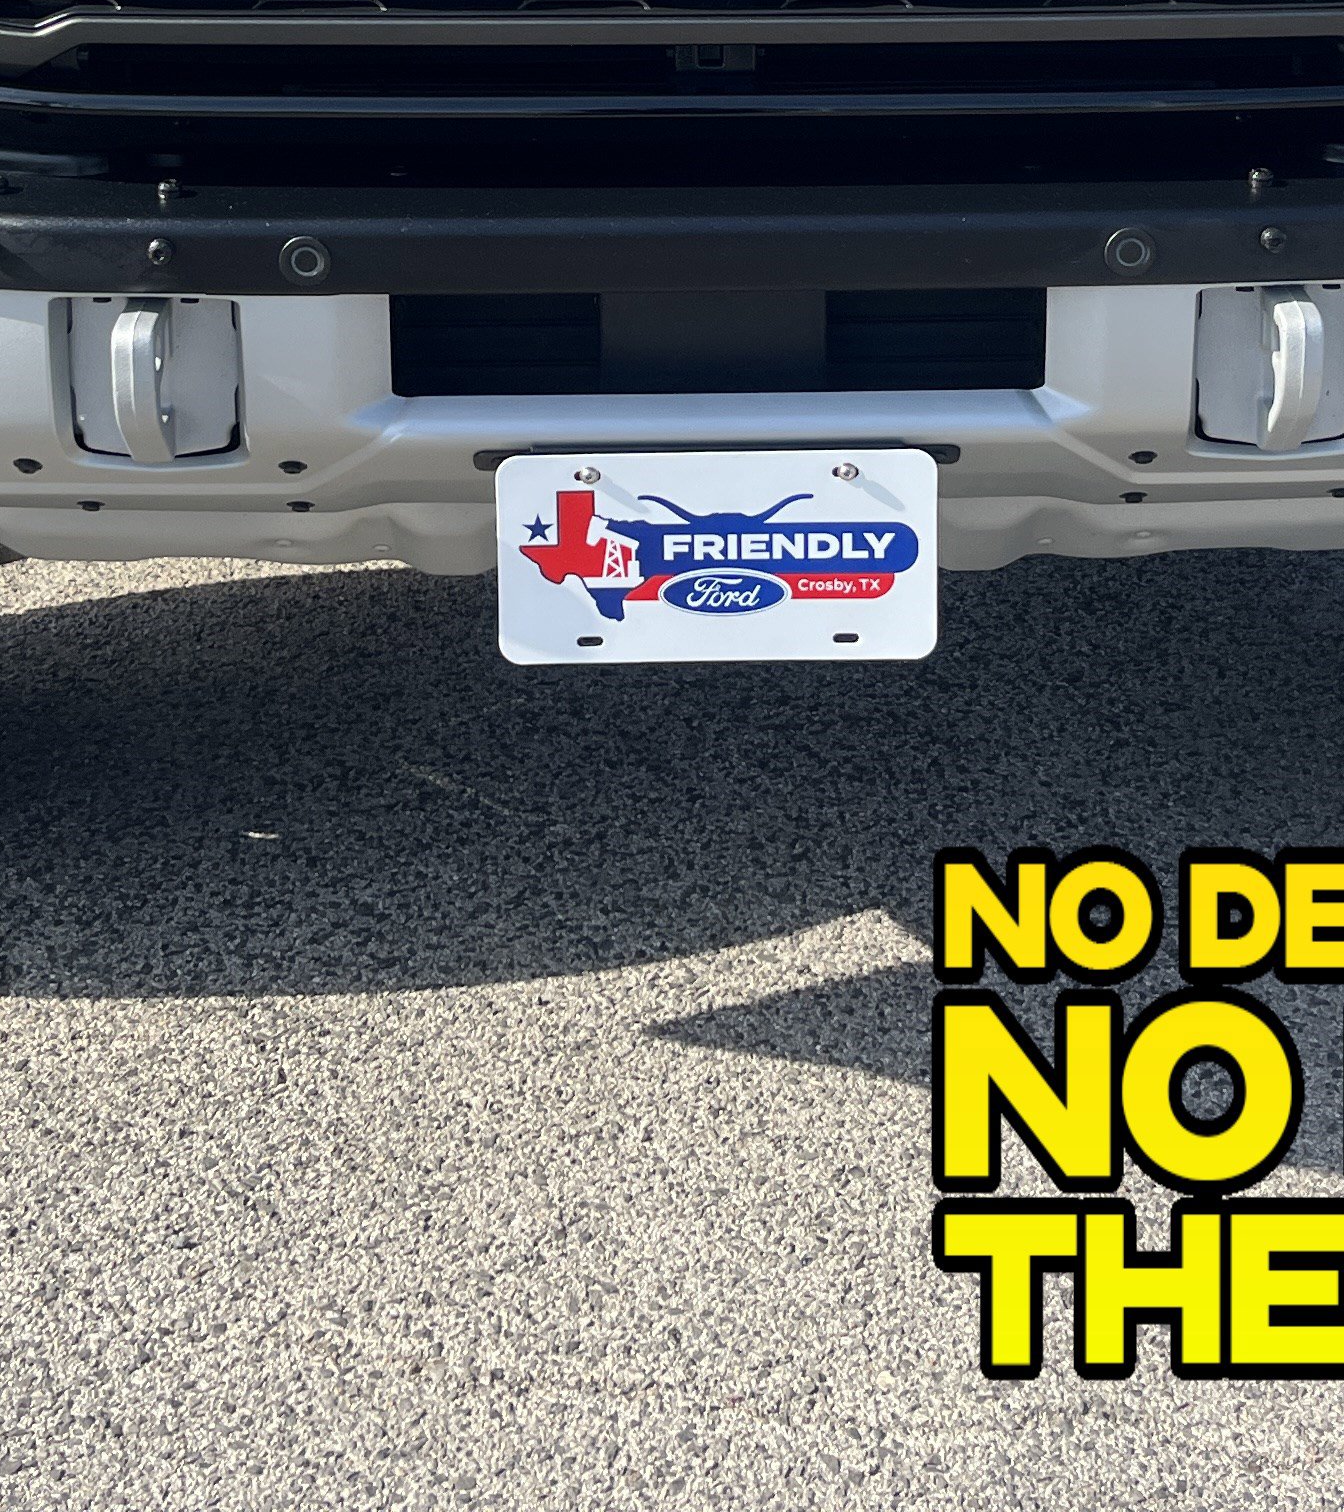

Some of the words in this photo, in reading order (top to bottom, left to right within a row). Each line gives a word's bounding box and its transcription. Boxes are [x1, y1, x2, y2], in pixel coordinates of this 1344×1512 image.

[662, 532, 896, 562] FRIENDLY
[685, 576, 762, 608] Ford
[797, 578, 857, 594] Crosby,
[858, 577, 881, 592] TX
